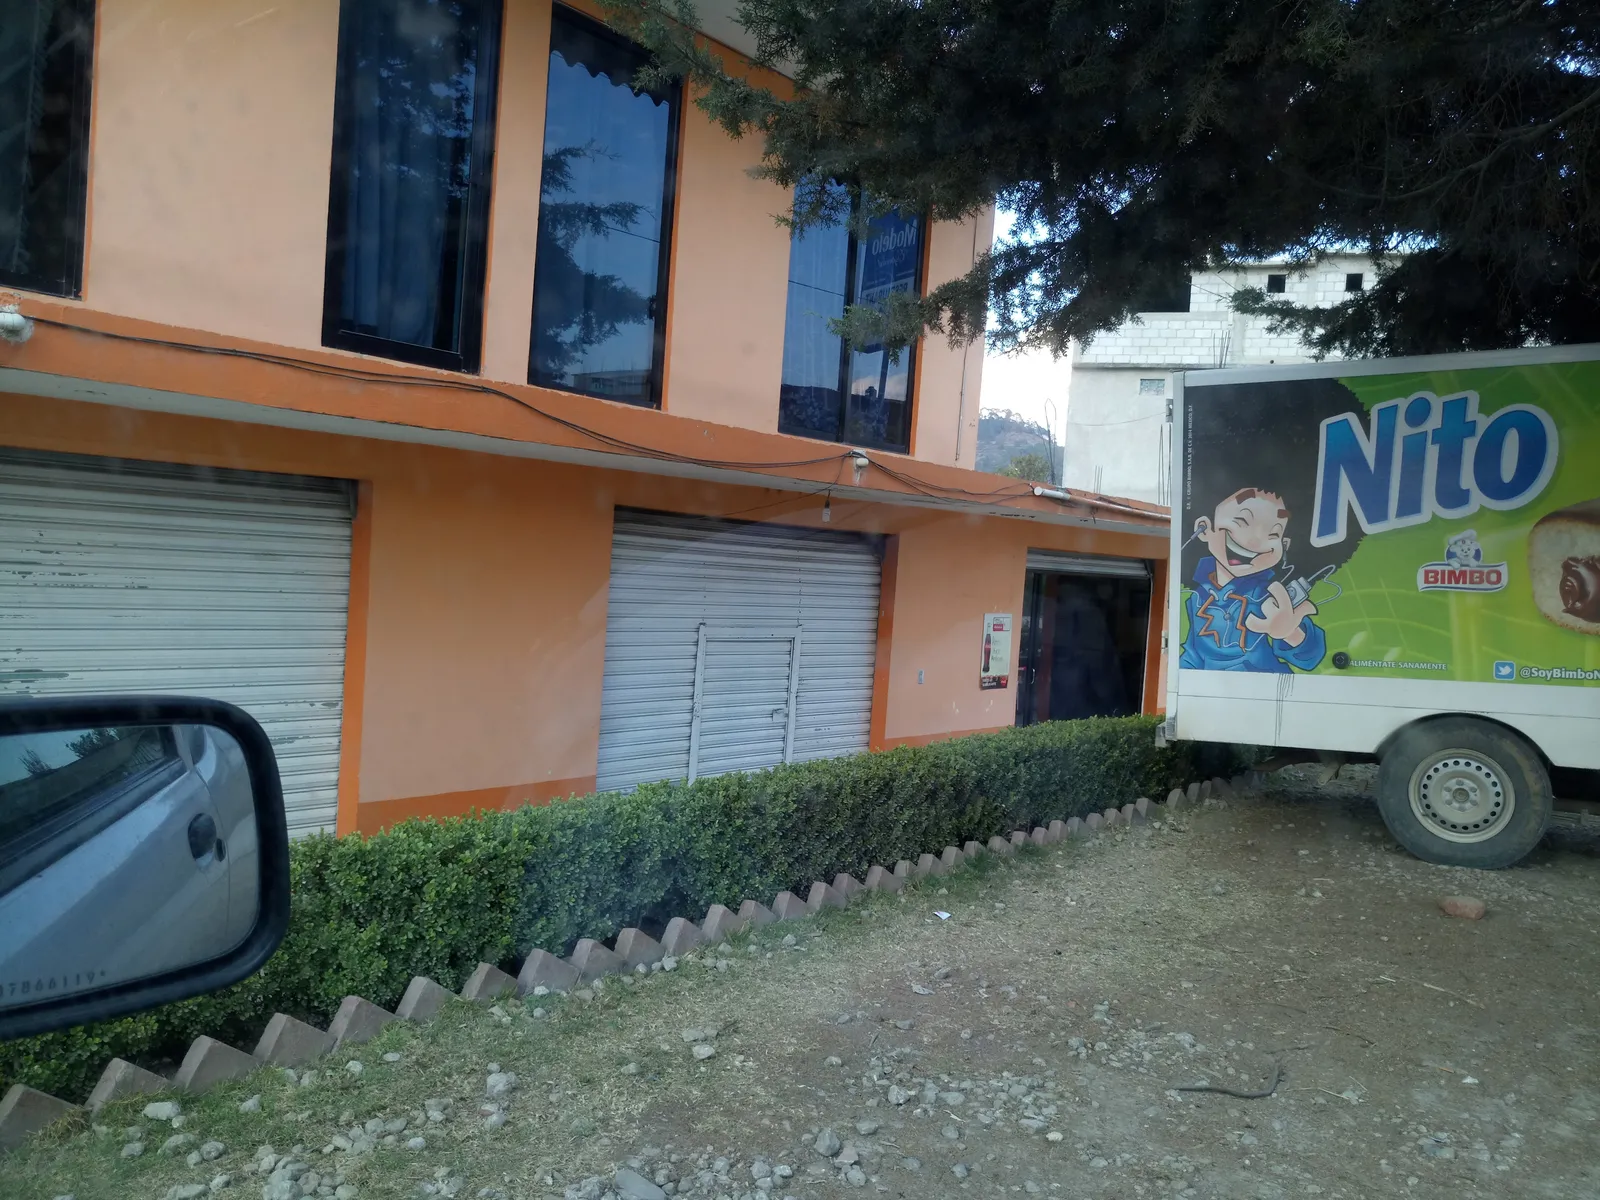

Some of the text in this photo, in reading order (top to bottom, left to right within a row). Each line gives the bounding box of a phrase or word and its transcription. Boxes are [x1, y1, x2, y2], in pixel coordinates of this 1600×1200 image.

[1315, 396, 1550, 540] Nito
[1423, 568, 1503, 586] BIMBO
[1398, 661, 1448, 671] SANAMENTE
